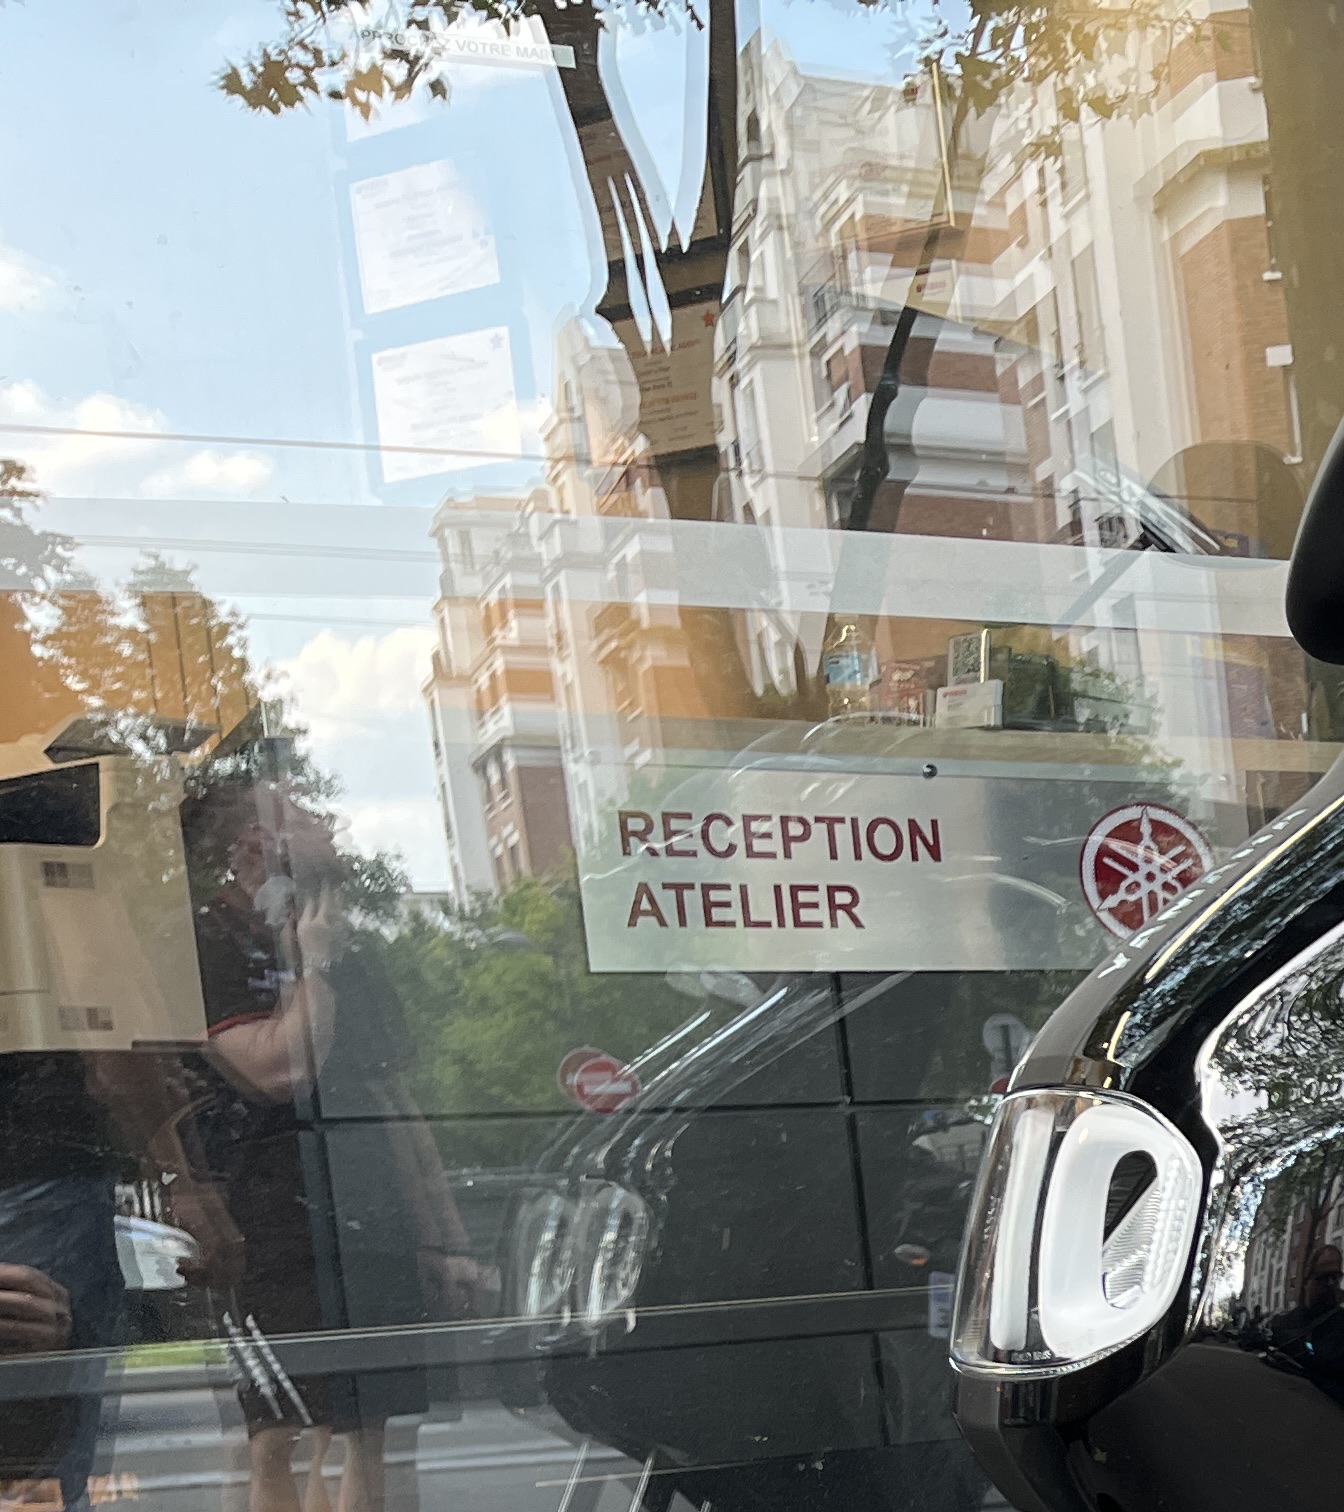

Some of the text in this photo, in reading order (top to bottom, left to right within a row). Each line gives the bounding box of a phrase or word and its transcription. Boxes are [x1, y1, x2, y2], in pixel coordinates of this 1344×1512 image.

[455, 38, 512, 57] VOTRE
[618, 809, 943, 864] RECEPTION
[626, 881, 865, 931] ATELIER
